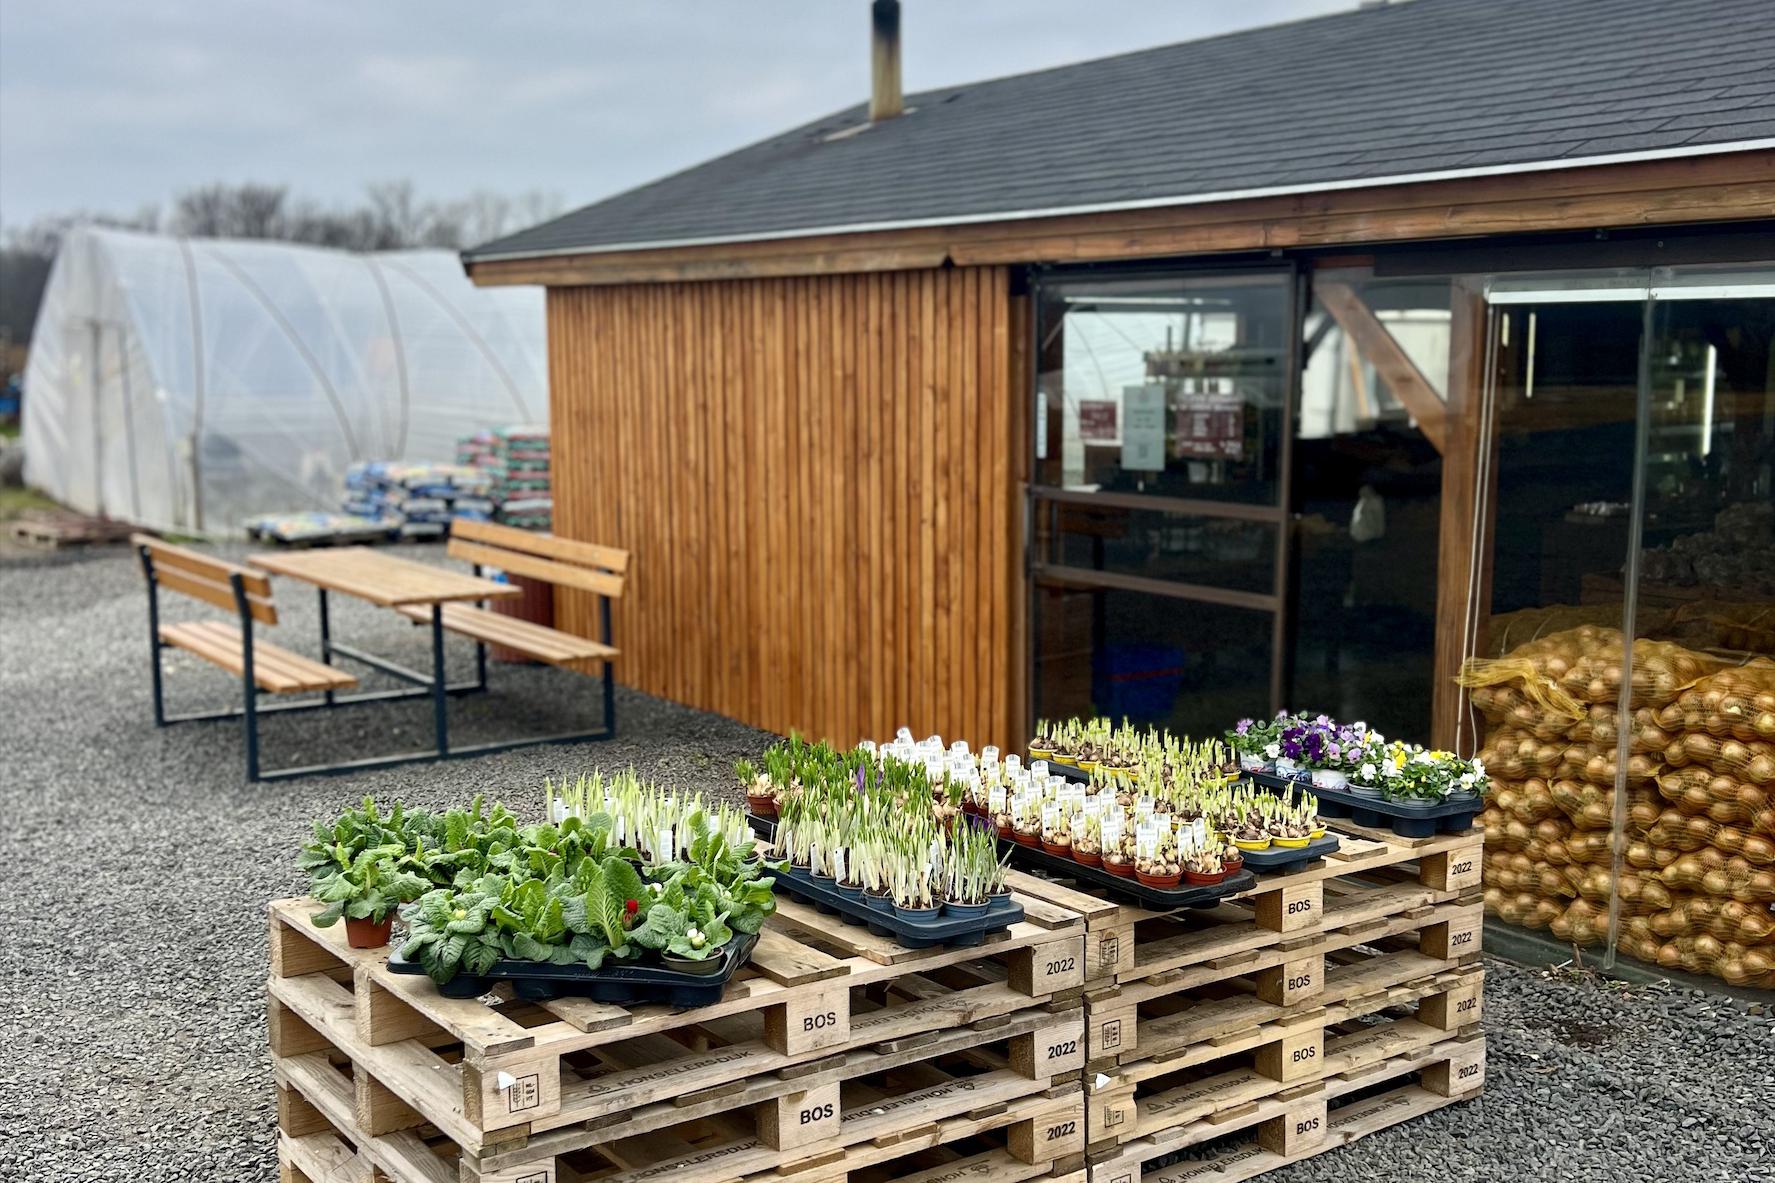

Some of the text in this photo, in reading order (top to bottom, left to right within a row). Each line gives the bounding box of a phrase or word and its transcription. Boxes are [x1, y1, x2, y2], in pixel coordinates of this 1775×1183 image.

[1452, 861, 1472, 875] 2022
[1288, 899, 1311, 914] BOS
[1451, 931, 1472, 947] 2022
[1046, 957, 1075, 976] 2022
[1288, 974, 1311, 991] BOS
[1456, 997, 1477, 1013] 2022
[803, 1012, 836, 1032] BOS
[1047, 1040, 1077, 1060] 2022
[1293, 1046, 1316, 1063] BOS
[1458, 1063, 1479, 1080] 2022
[800, 1103, 834, 1125] BOS
[1047, 1121, 1076, 1142] 2022
[1296, 1118, 1319, 1135] BOS
